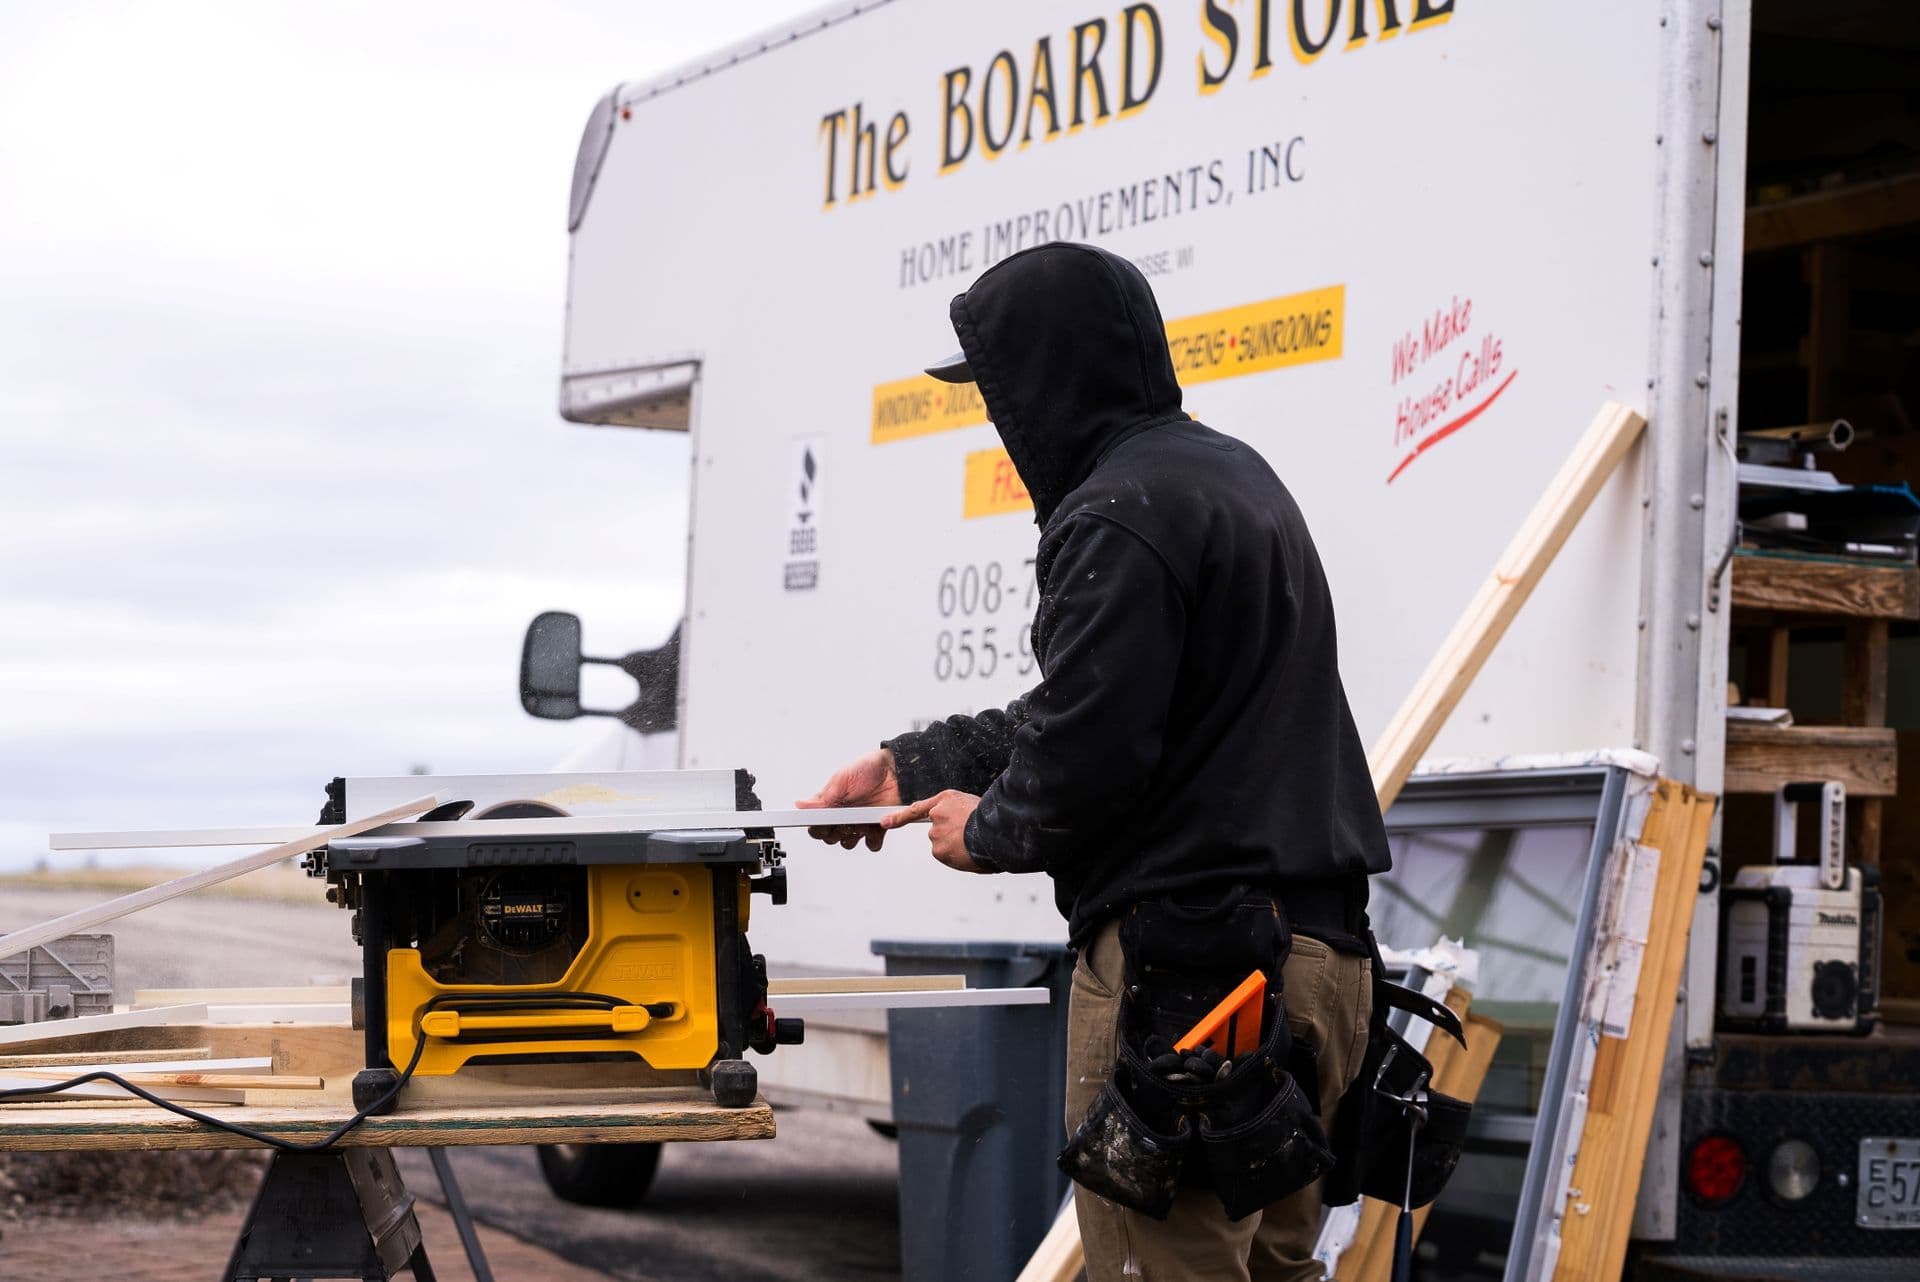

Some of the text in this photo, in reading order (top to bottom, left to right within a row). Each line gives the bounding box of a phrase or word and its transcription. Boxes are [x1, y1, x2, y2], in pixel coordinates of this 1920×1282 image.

[817, 102, 911, 211] The
[937, 2, 1164, 178] BOARD
[899, 136, 1307, 288] HOME IMPROVEMENTS, INC
[1169, 329, 1227, 373] TCHENS
[1236, 308, 1333, 362] SUNROOMS
[1392, 295, 1472, 385] We Make
[1395, 333, 1503, 447] House Calls
[937, 558, 1037, 618] 608-7
[934, 622, 1036, 682] 855-9
